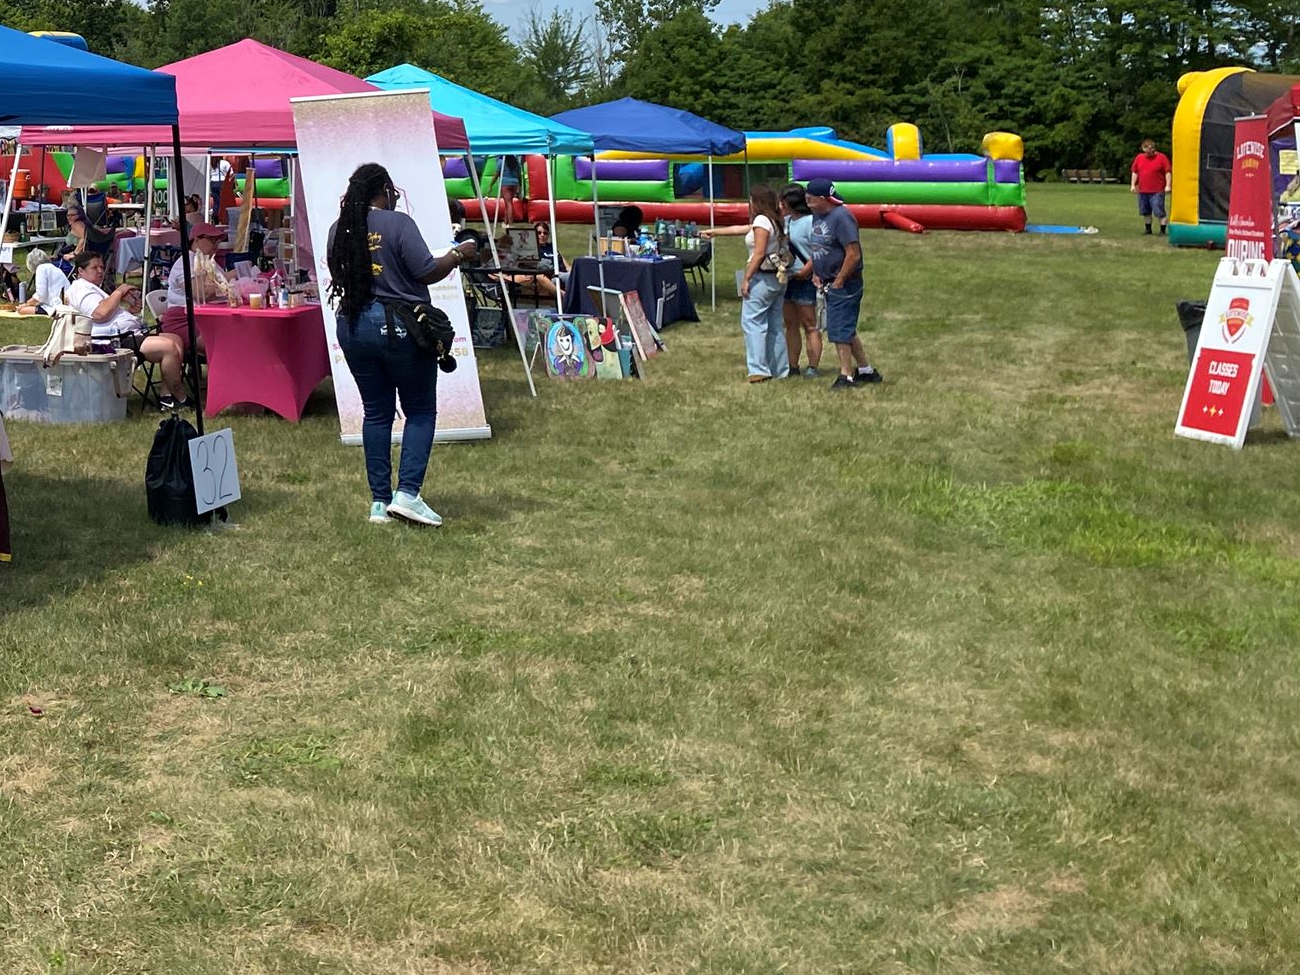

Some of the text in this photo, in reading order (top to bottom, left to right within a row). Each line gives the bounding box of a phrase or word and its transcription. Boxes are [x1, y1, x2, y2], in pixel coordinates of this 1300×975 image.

[1227, 239, 1265, 262] DURING
[1208, 360, 1239, 378] CLASSES
[1208, 379, 1231, 396] TODAY
[197, 435, 232, 505] 32
